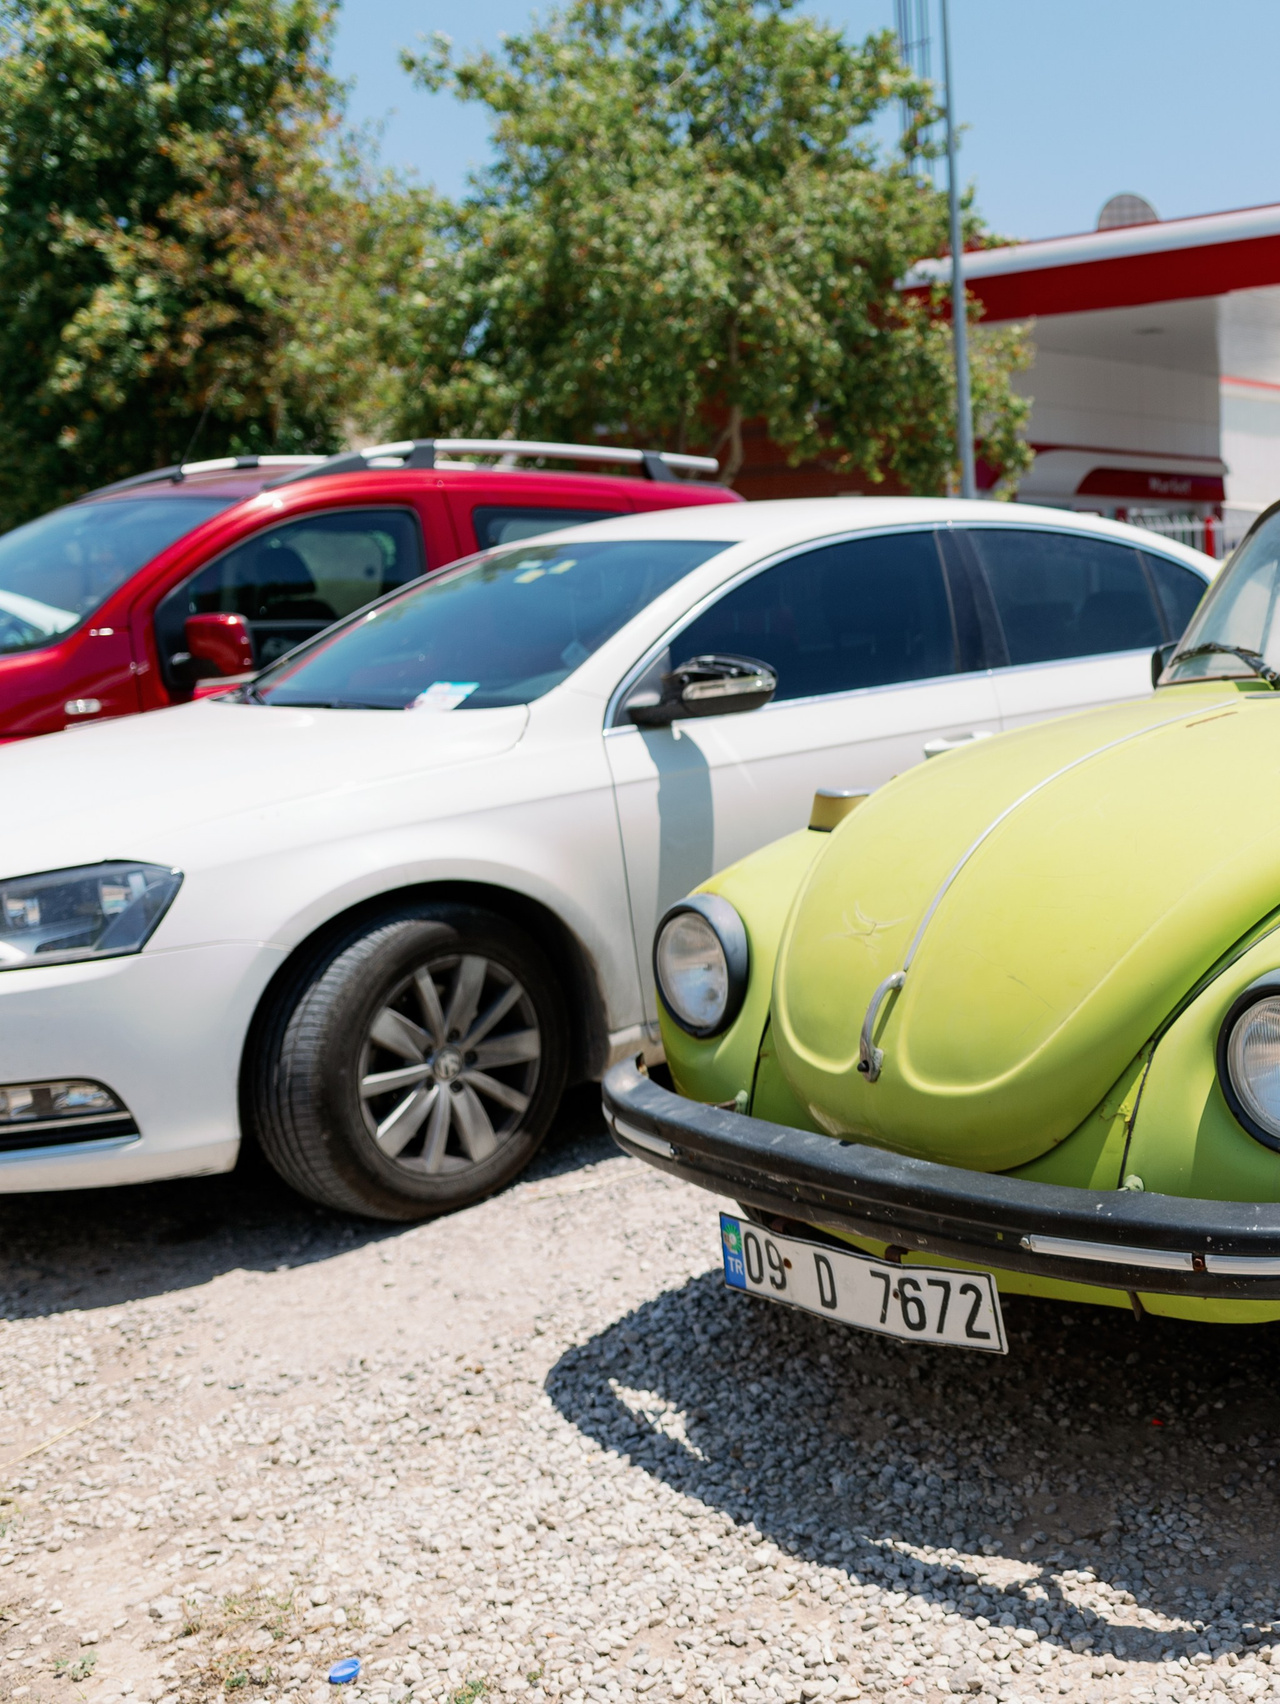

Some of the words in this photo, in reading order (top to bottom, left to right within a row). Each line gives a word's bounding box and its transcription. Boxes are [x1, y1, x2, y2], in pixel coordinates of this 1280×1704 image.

[727, 1255, 744, 1276] TR
[743, 1231, 787, 1291] 09
[813, 1252, 837, 1310] D
[869, 1269, 991, 1340] 7672
